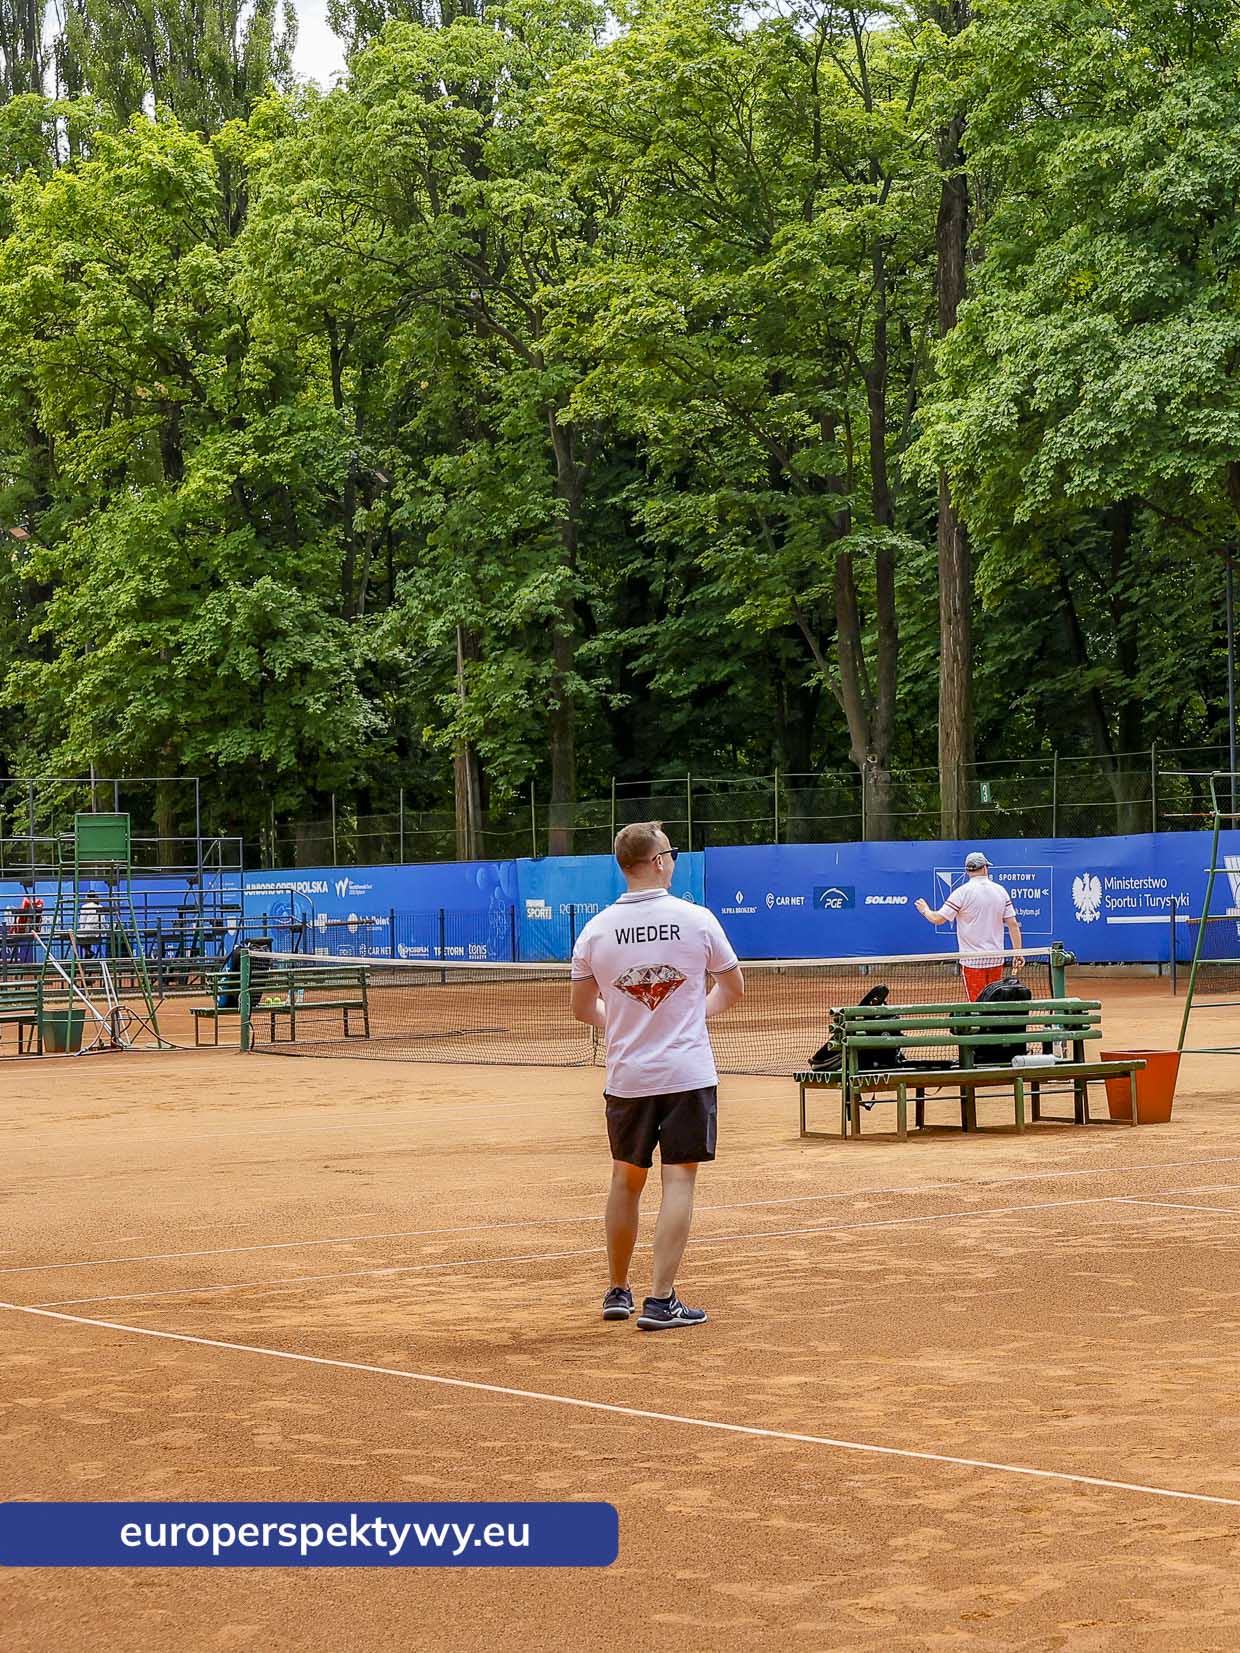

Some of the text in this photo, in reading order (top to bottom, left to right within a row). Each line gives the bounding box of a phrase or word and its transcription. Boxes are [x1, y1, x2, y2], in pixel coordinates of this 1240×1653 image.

[999, 873, 1036, 881] SPORTOWY
[1104, 876, 1168, 890] Ministerstwo
[297, 880, 329, 894] POLSKA
[776, 896, 805, 906] CAR NET
[824, 898, 842, 909] PGE
[864, 895, 908, 905] SOLANO
[1105, 895, 1137, 910] Sportu
[1144, 892, 1190, 910] Turystyki
[615, 924, 681, 945] WIEDER
